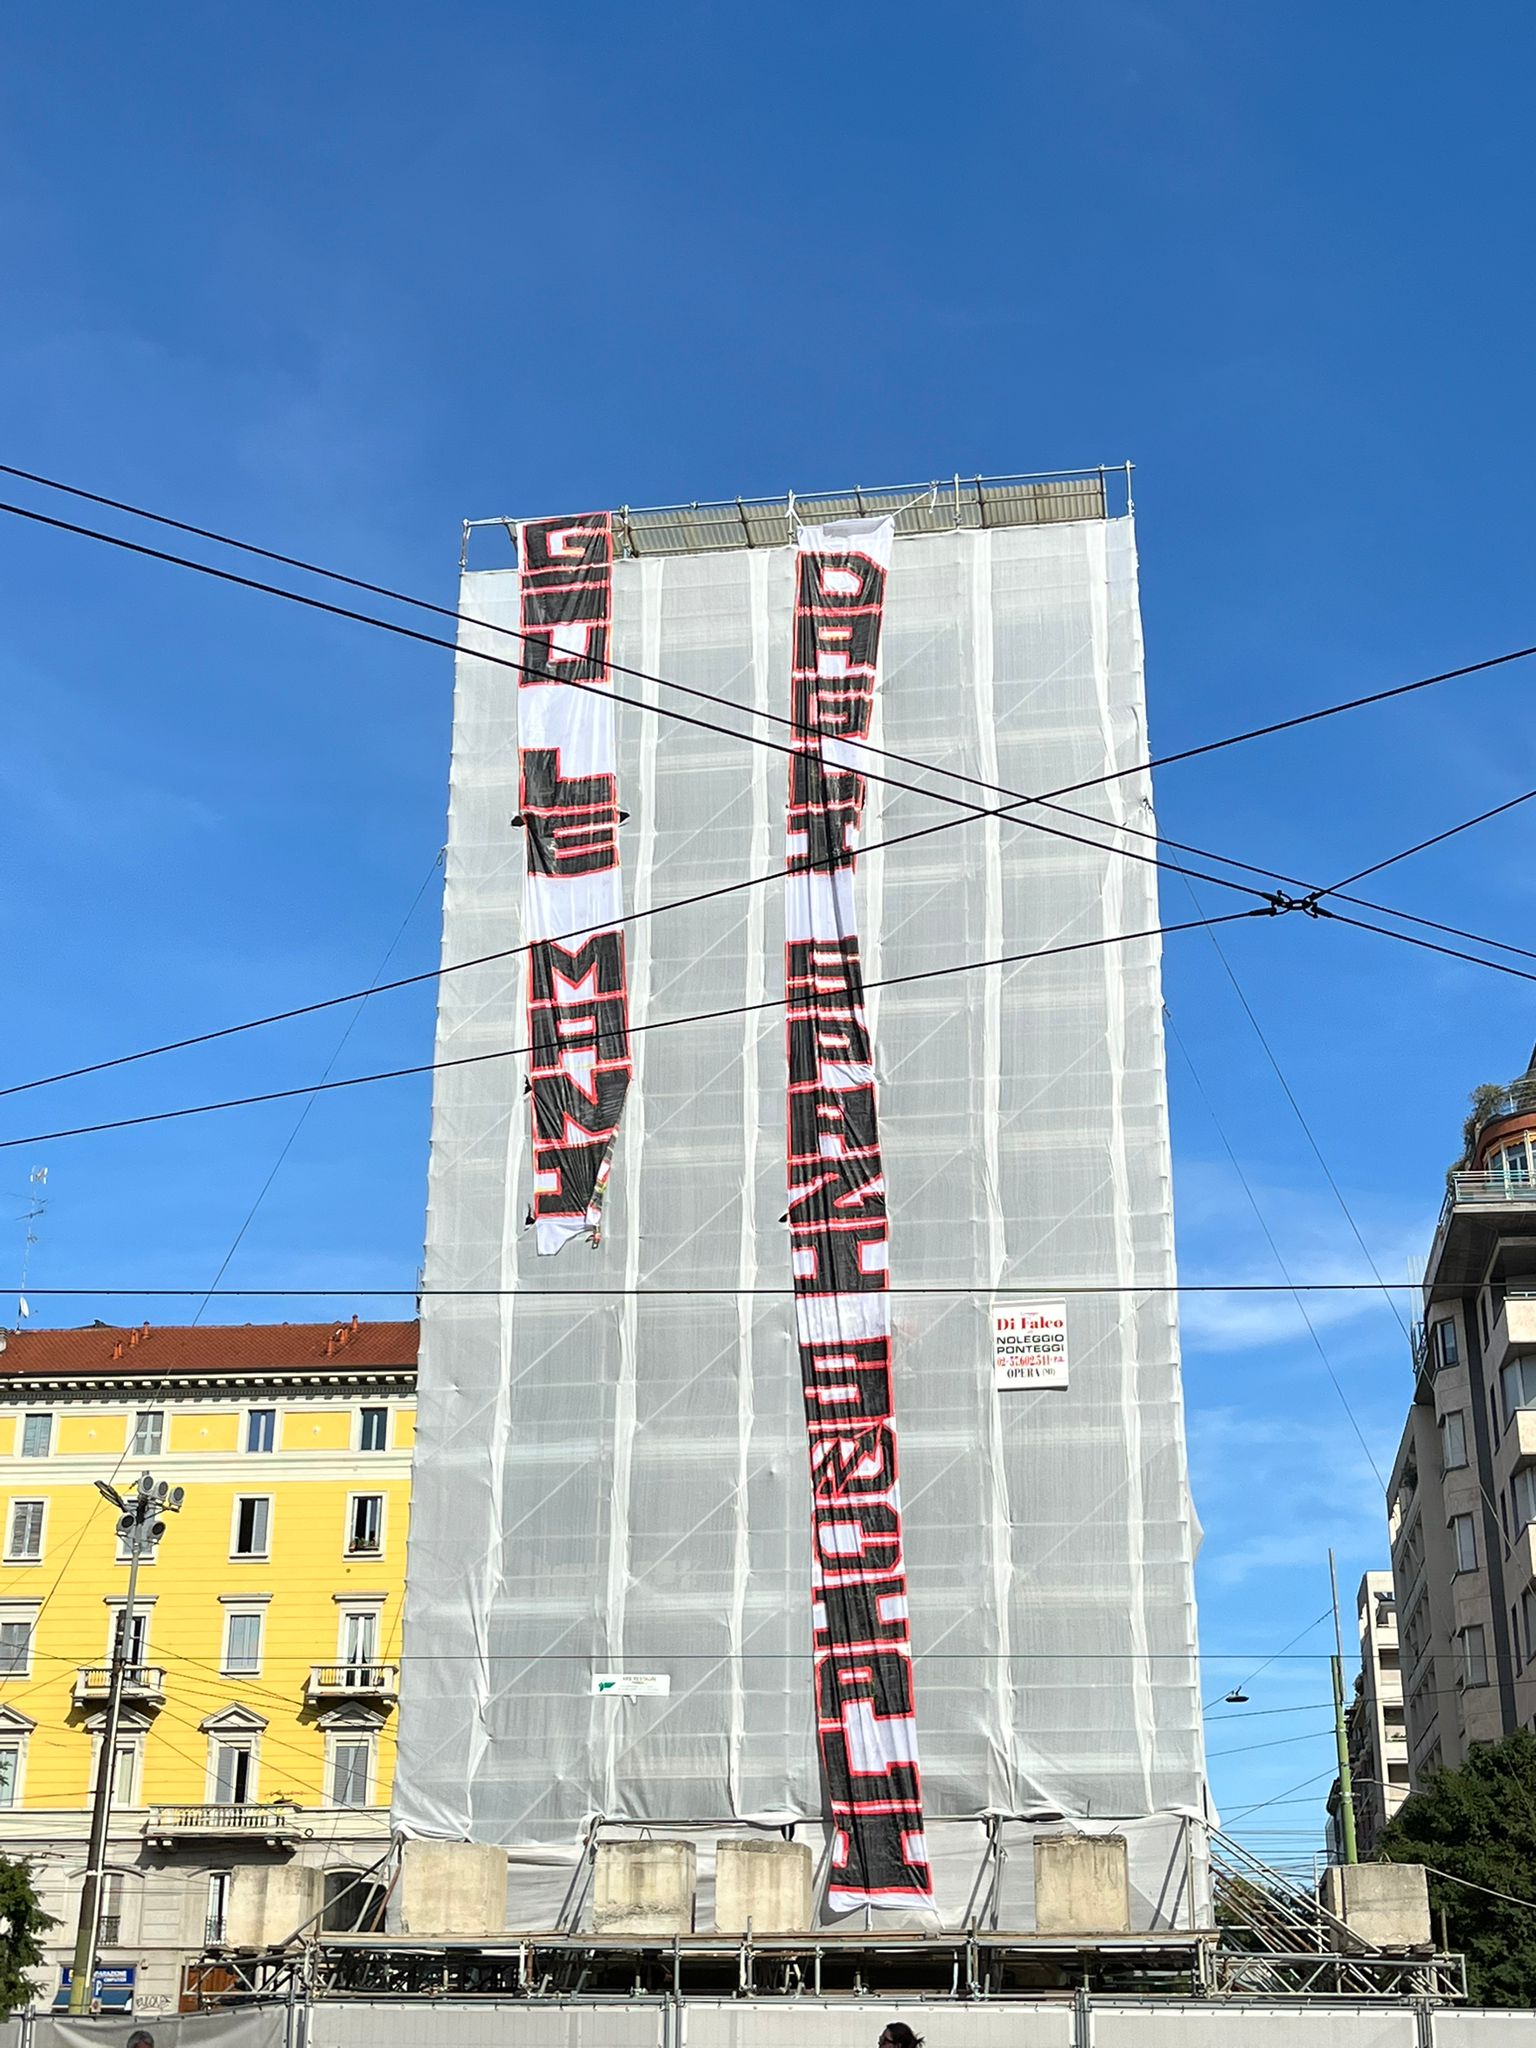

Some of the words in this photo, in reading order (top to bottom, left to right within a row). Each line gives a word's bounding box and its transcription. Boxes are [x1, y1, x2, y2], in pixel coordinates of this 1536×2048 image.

[518, 747, 620, 880] LE
[527, 929, 632, 1220] MANI
[785, 936, 889, 1298] SPAZI
[997, 1318, 1015, 1331] Di
[997, 1334, 1064, 1345] NOLEGGIO
[997, 1344, 1064, 1354] PONTEGGI
[1006, 1368, 1040, 1378] OPERA
[800, 1336, 932, 1895] SOCIALI
[95, 1980, 102, 1996] P
